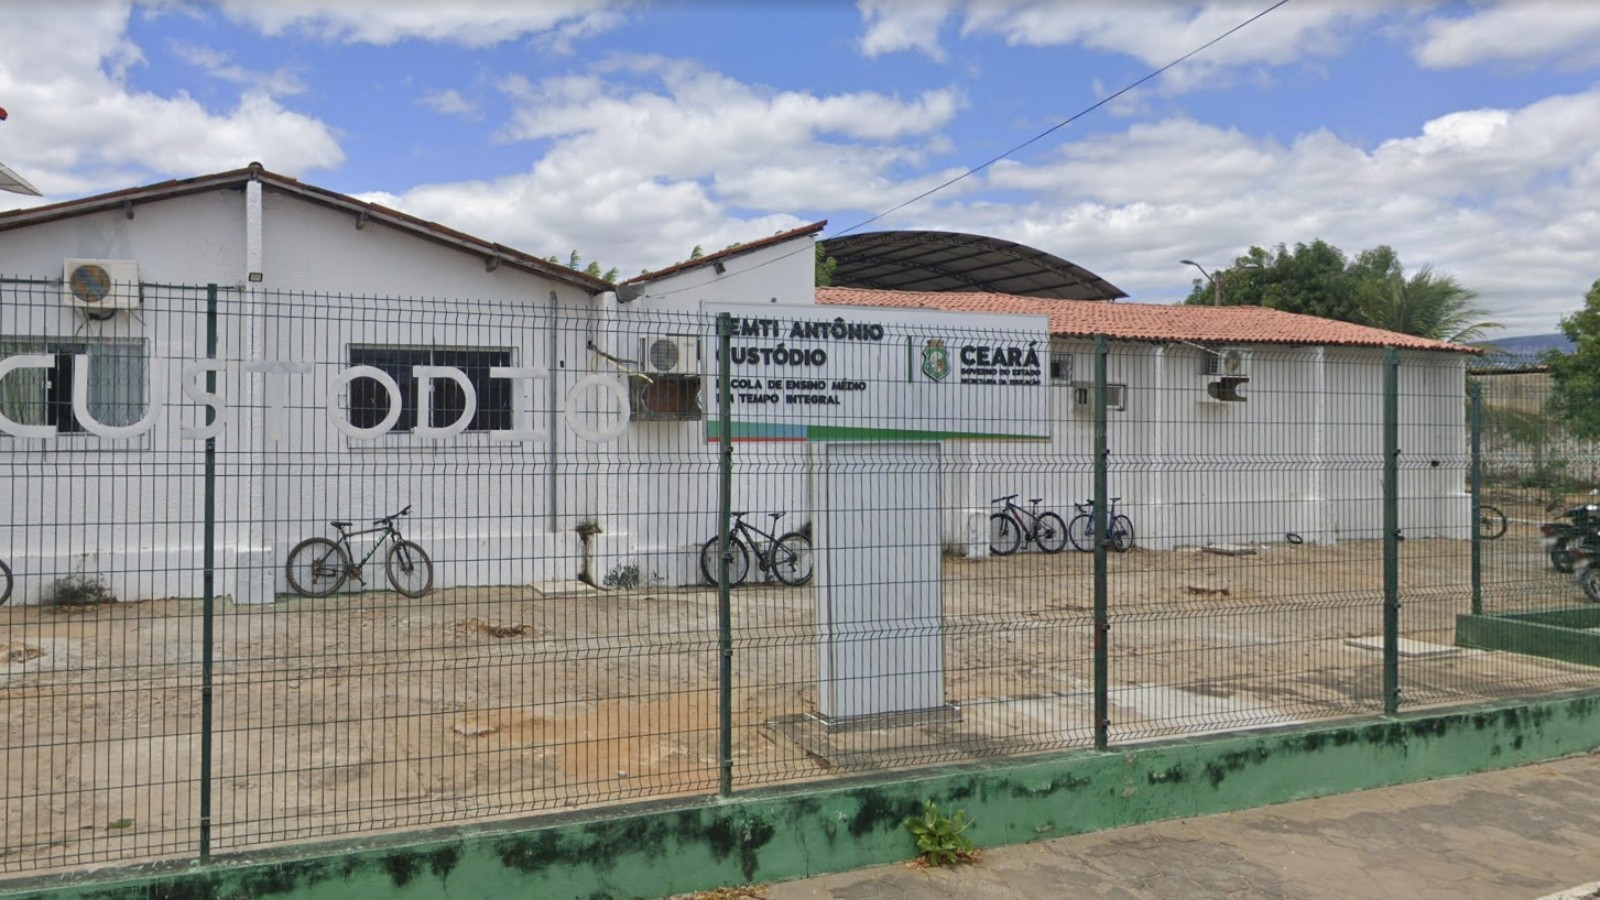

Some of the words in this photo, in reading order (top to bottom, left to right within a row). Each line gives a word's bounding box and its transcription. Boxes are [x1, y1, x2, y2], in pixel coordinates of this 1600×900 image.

[716, 317, 779, 337] EMTI
[790, 317, 884, 341] ANTÔNIO
[716, 343, 827, 366] USTÓDIO
[960, 340, 1040, 367] CEARÁ
[716, 379, 762, 389] COLA
[768, 380, 782, 389] DE
[786, 381, 826, 390] ENSINO
[832, 378, 866, 391] MÉDIO
[0, 353, 632, 444] CUSTODIO
[739, 394, 779, 404] TEMPO
[786, 395, 840, 405] INTEGRAL
